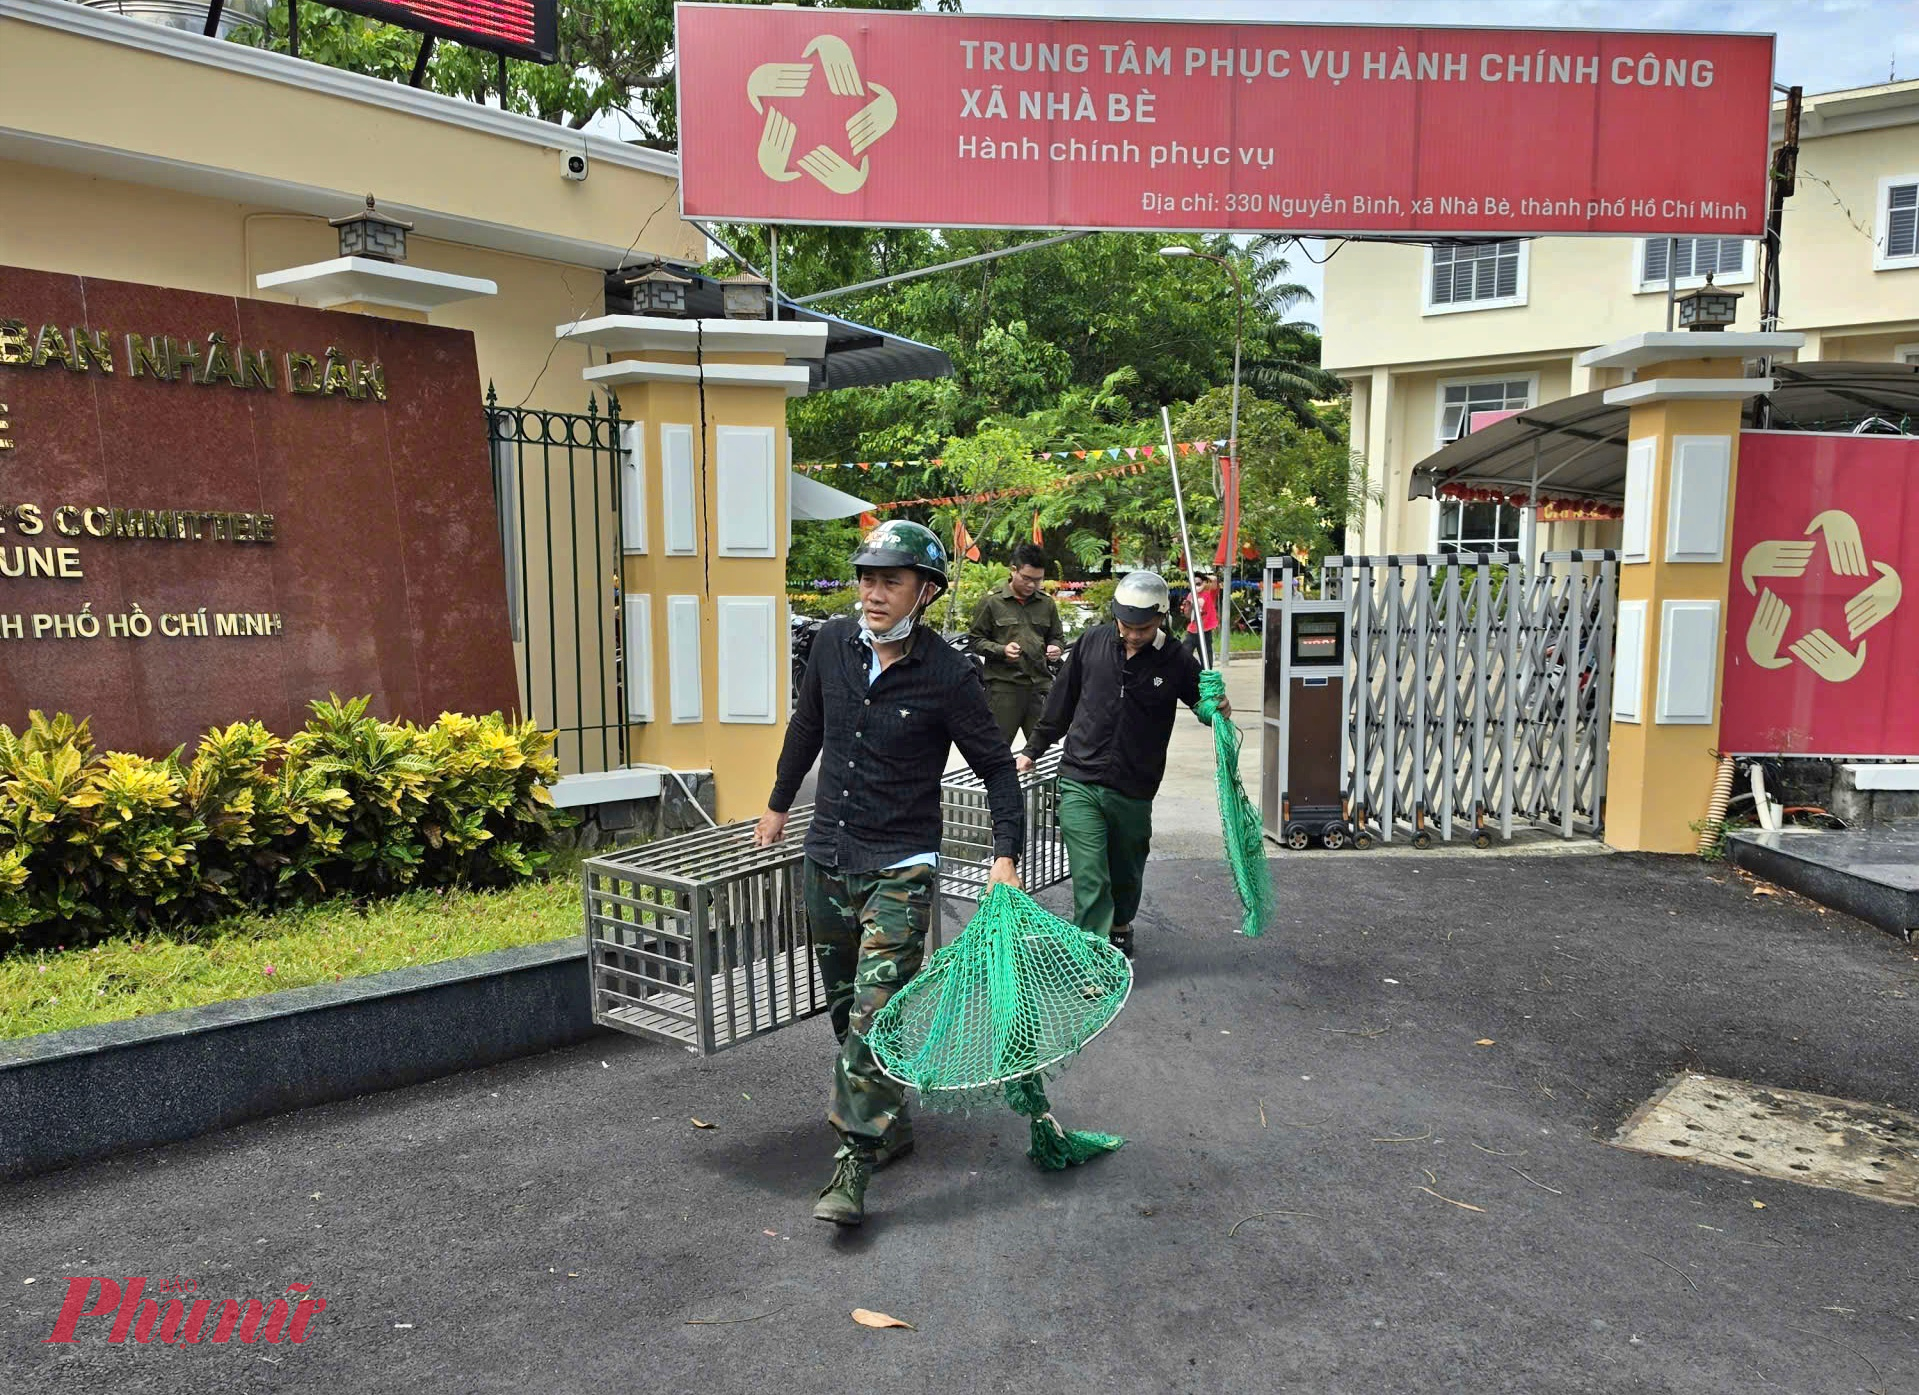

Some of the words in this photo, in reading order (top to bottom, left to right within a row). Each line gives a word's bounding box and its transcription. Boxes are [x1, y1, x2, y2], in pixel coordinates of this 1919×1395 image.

[959, 40, 1089, 73] TRUNG
[1099, 39, 1172, 76] TÂM
[1184, 47, 1291, 84] PHỤC
[1300, 49, 1350, 86] VỤ
[1362, 45, 1468, 81] HÀNH
[1479, 48, 1599, 84] CHÍNH
[1610, 51, 1714, 88] CÔNG
[959, 84, 1008, 119] XÃ
[1018, 86, 1098, 122] NHÀ
[1107, 88, 1157, 123] BÈ
[958, 135, 1039, 161] Hành
[1049, 137, 1140, 163] chính
[1150, 141, 1231, 169] phục
[1238, 146, 1275, 170] vụ
[1141, 192, 1175, 215] Địa
[1181, 192, 1219, 212] chỉ:
[1224, 193, 1263, 212] 330
[1267, 192, 1347, 218] Nguyễn
[1352, 195, 1406, 218] Bình,
[1411, 198, 1434, 215] xã
[1439, 196, 1478, 215] Nhà
[1483, 196, 1515, 219] Bè,
[1520, 197, 1581, 216] thành
[1586, 196, 1626, 220] phố
[1631, 199, 1657, 217] Hồ
[1662, 199, 1695, 218] Chí
[1700, 200, 1747, 220] Minh
[0, 318, 114, 373] BAN
[125, 332, 276, 389] NHÂN
[282, 345, 387, 401] DÂN
[53, 505, 276, 541] COMMITTEE
[31, 602, 101, 638] PHỐ
[106, 602, 153, 638] HỒ
[158, 607, 209, 637] CHÍ
[213, 613, 282, 637] MINH
